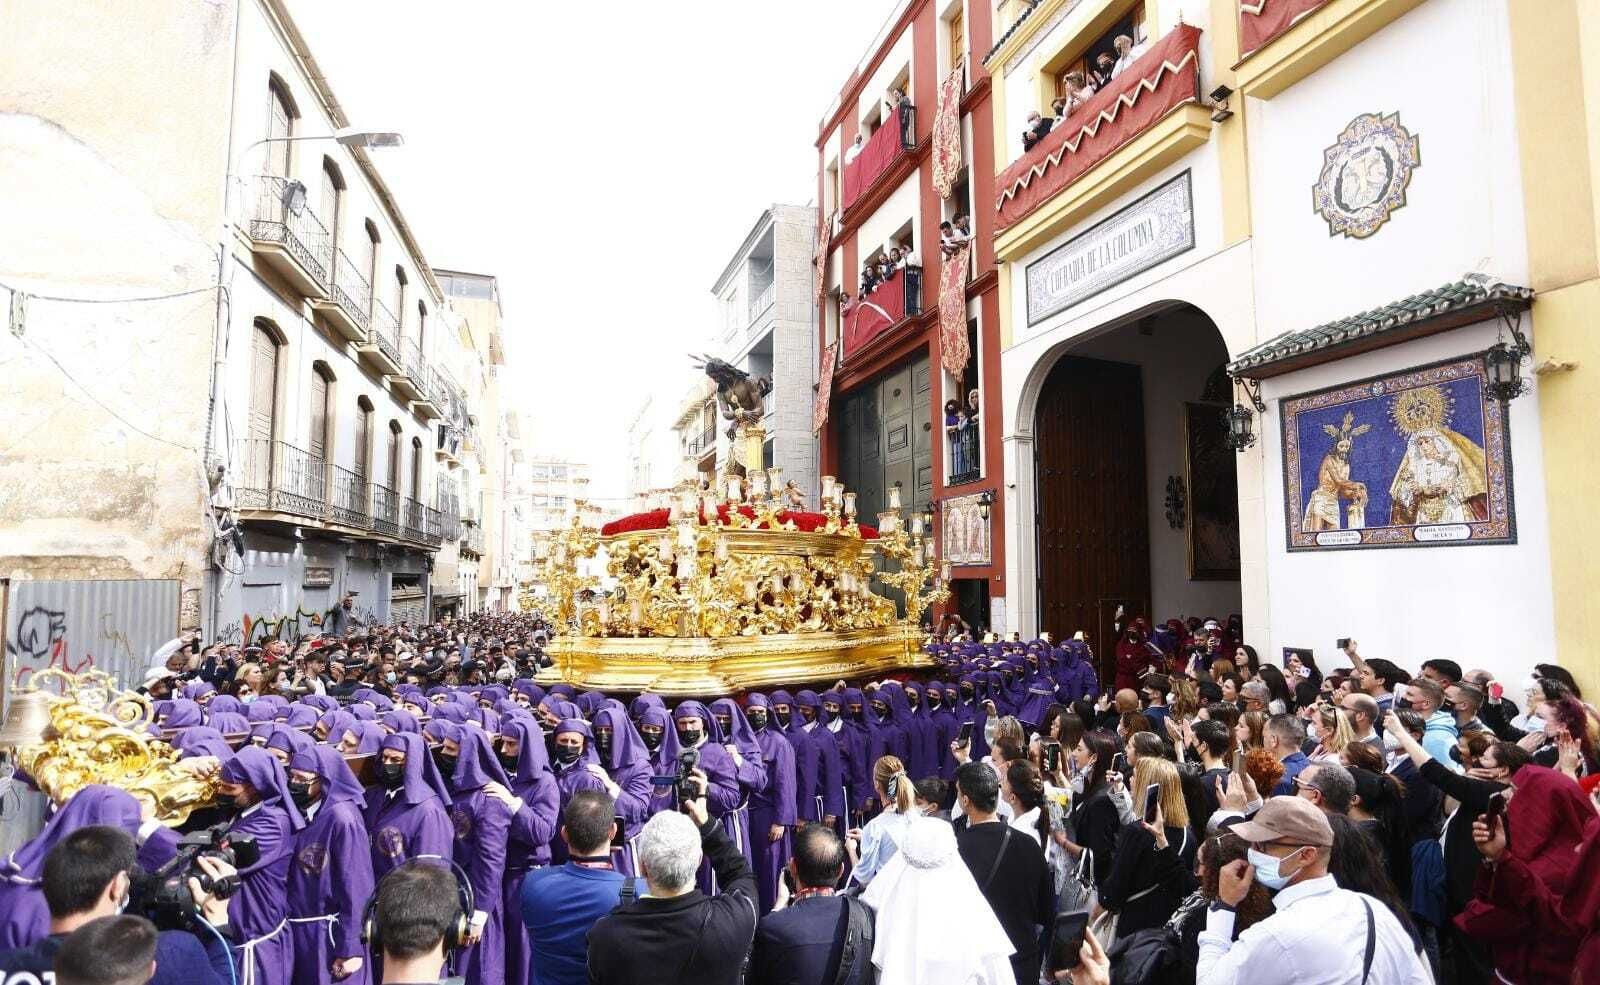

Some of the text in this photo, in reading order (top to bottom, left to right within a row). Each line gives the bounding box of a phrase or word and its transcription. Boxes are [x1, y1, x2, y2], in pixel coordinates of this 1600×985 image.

[1087, 248, 1097, 274] DE
[1099, 241, 1111, 268] LA
[1113, 217, 1154, 261] COLUMNA
